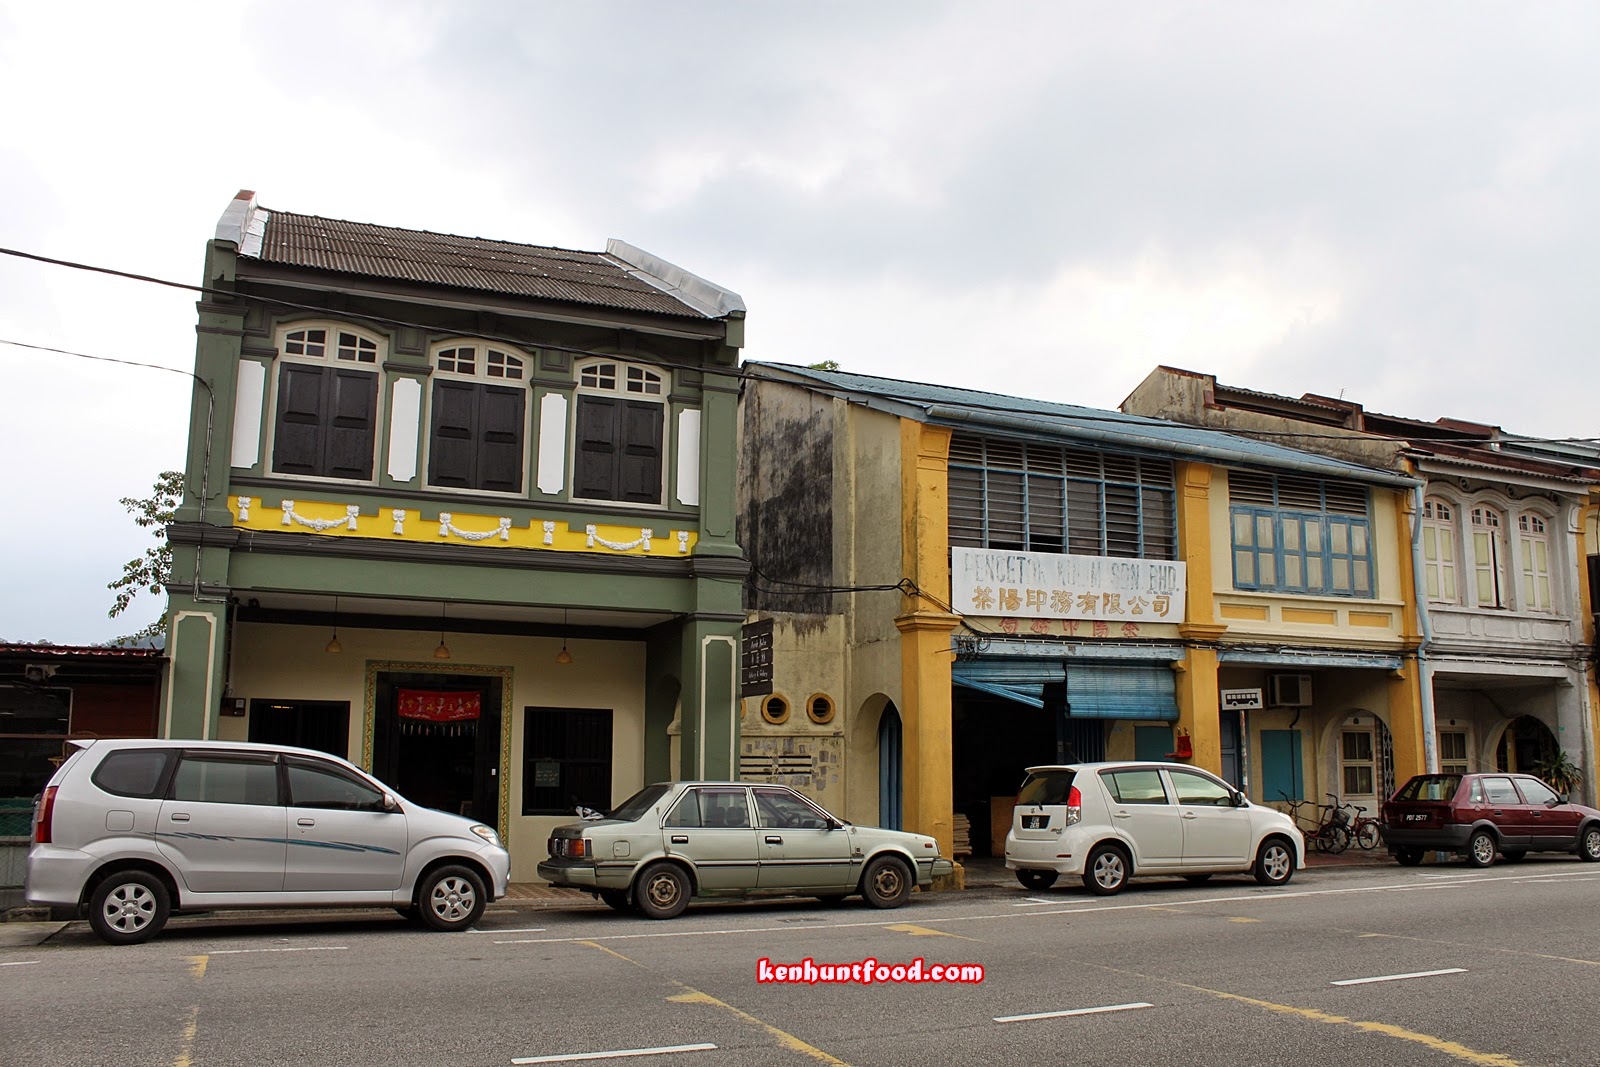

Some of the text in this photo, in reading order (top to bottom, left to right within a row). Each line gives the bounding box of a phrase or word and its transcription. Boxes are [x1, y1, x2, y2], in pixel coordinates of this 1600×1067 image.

[1149, 564, 1179, 592] BHD.
[972, 585, 1171, 617] 茶陽印務有限公司
